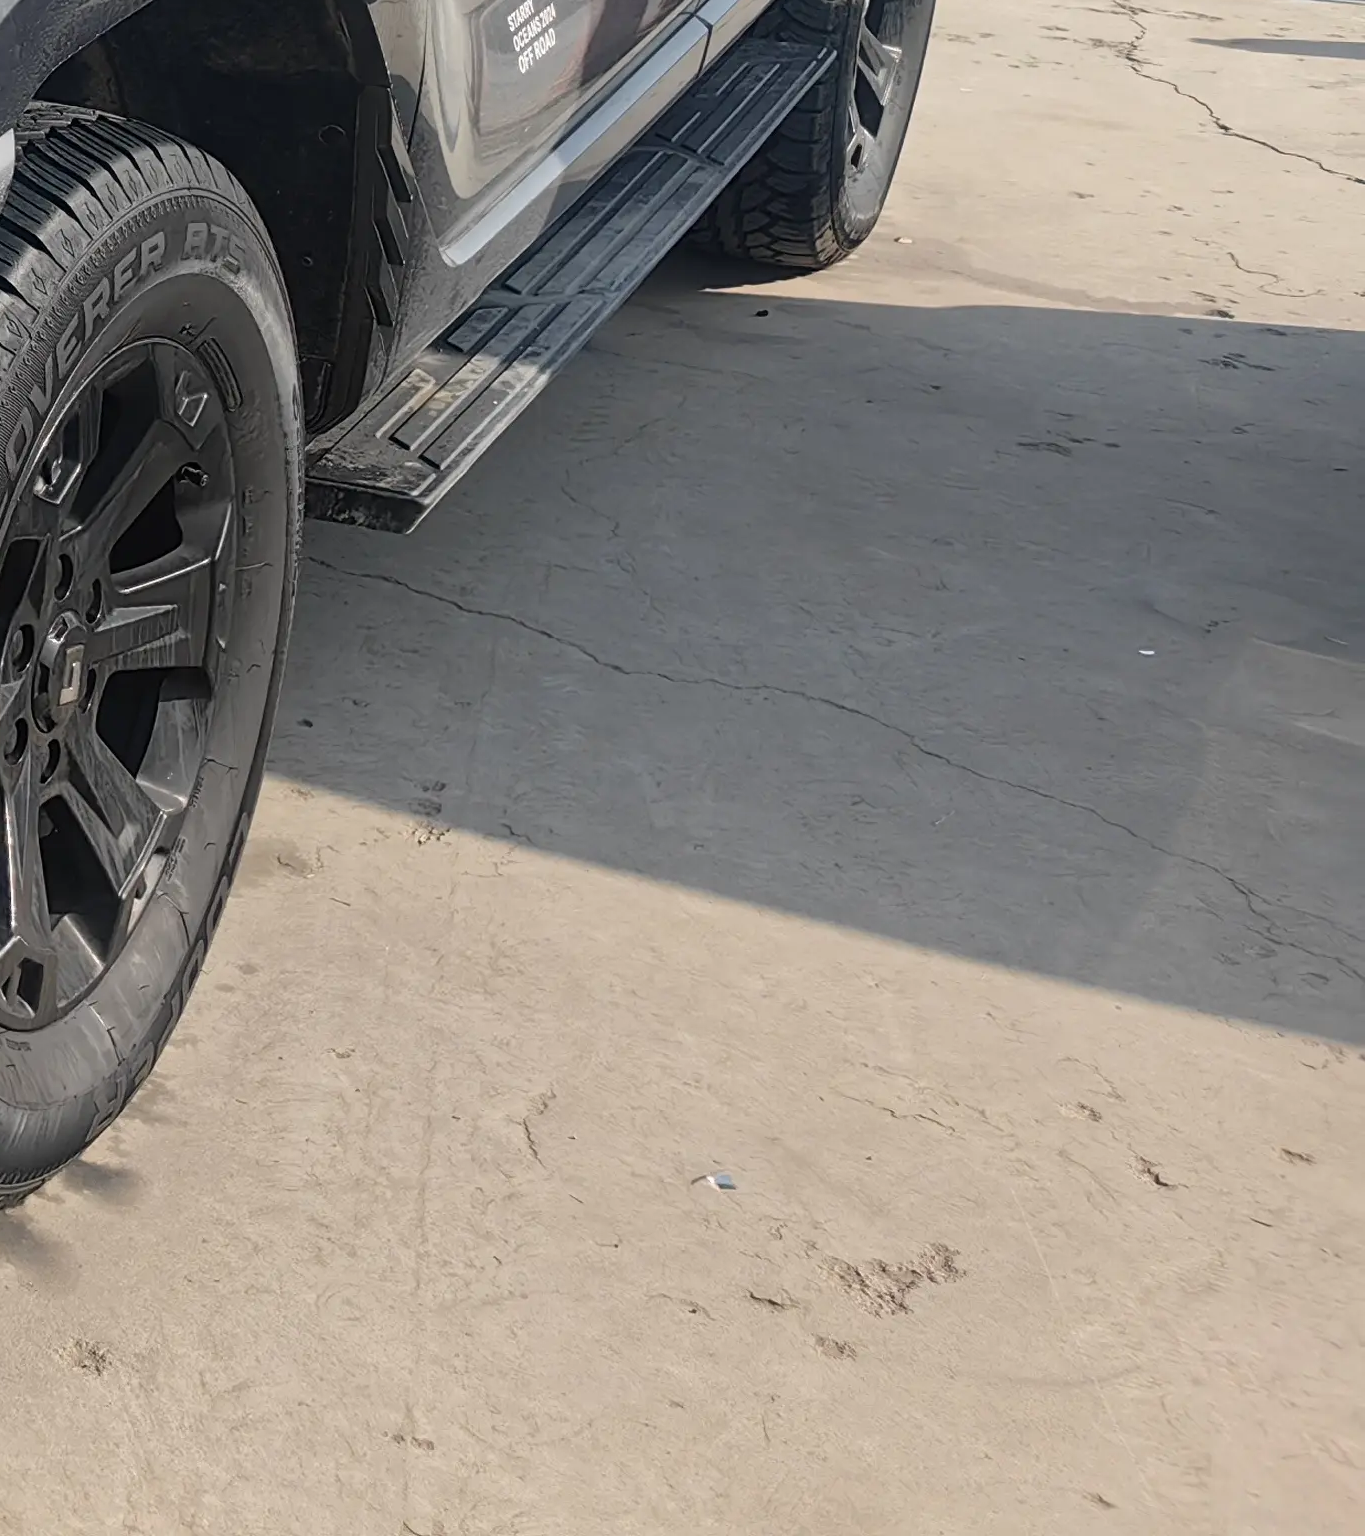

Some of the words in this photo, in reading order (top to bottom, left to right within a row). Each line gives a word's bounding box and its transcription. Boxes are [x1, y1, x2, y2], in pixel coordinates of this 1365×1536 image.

[513, 16, 542, 52] OCEANS
[518, 45, 534, 74] OFF
[533, 28, 556, 61] ROAD
